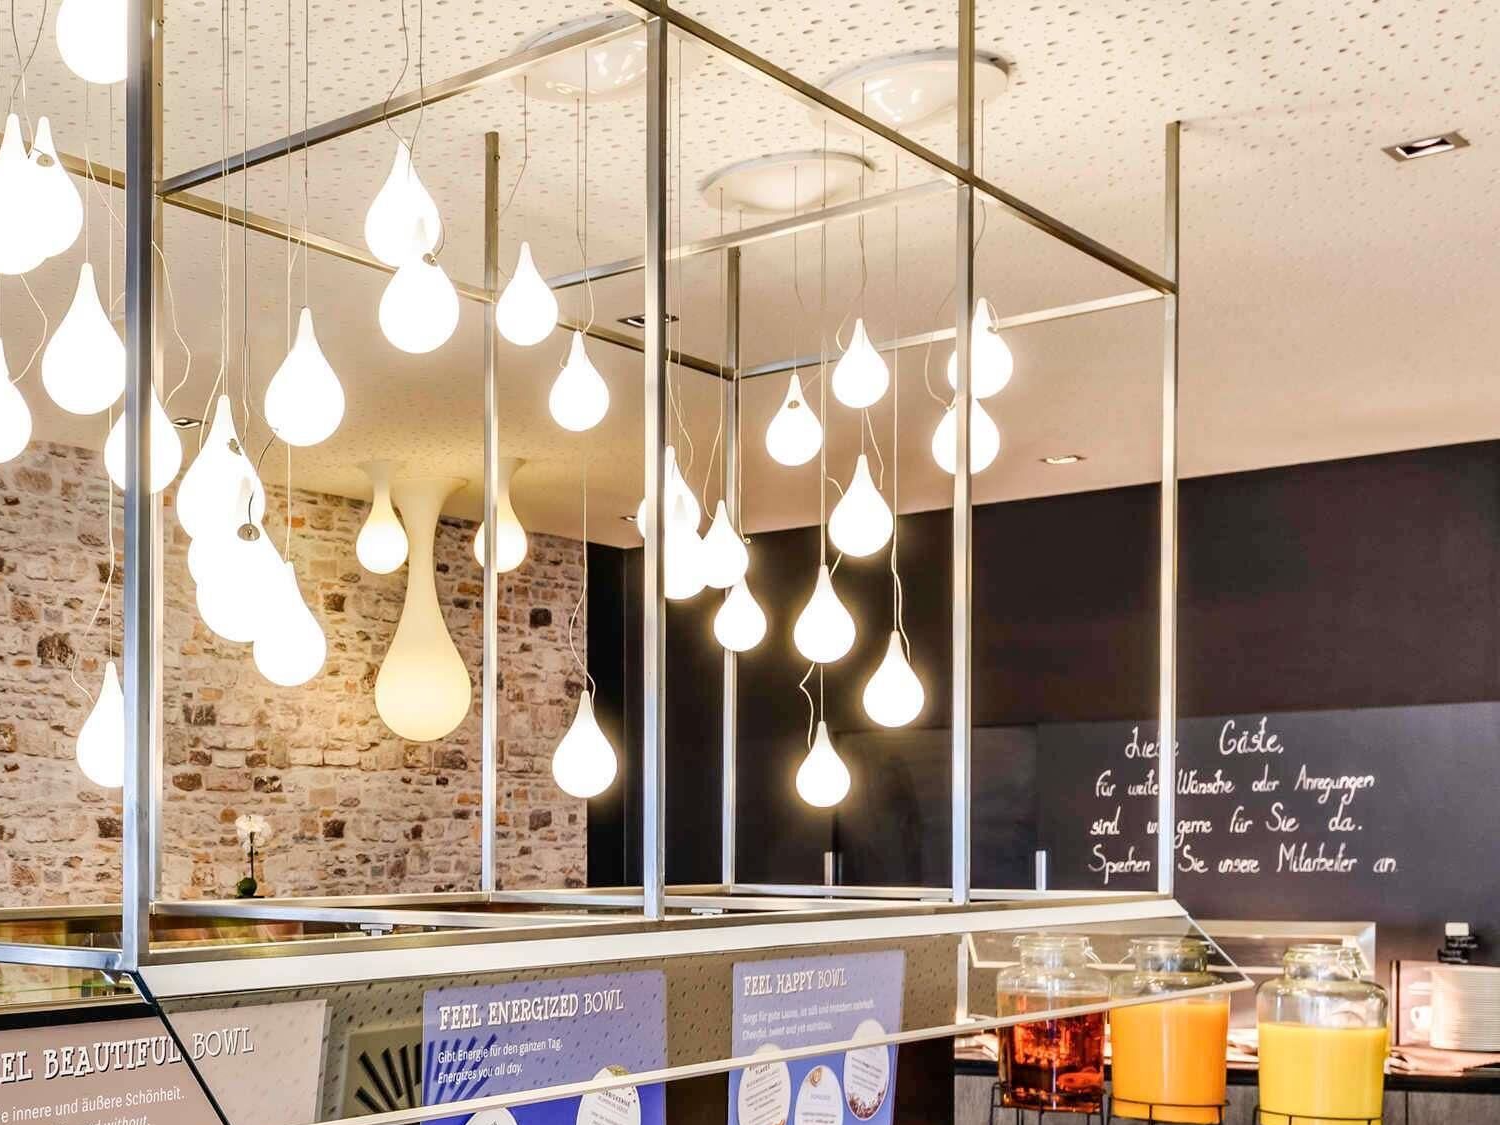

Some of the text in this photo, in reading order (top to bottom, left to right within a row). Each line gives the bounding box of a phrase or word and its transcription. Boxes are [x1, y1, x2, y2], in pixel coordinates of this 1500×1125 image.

[1219, 716, 1284, 755] Gäste,
[1252, 765, 1279, 793] oder
[1294, 765, 1374, 805] Anregungen
[1090, 806, 1120, 835] sind
[1175, 818, 1212, 849] gerne
[1230, 806, 1253, 832] für
[1266, 802, 1300, 832] Sie
[1329, 804, 1363, 832] da.
[1088, 842, 1397, 885] Sprechen Sie unsere Mitarbeiter an
[743, 968, 847, 996] FEEL HAPPY BOWL
[439, 989, 624, 1032] FEEL ENERGIZED BOWL
[44, 1035, 184, 1080] BEAUTIFUL
[192, 1026, 254, 1060] BOWL
[438, 1038, 563, 1064] Gibt Energie für den ganzen Tag.
[438, 1062, 523, 1085] Energizes you all day.
[12, 1102, 51, 1121] innere
[54, 1098, 78, 1116] und
[82, 1093, 123, 1113] äußere
[125, 1086, 185, 1107] Schönheit.
